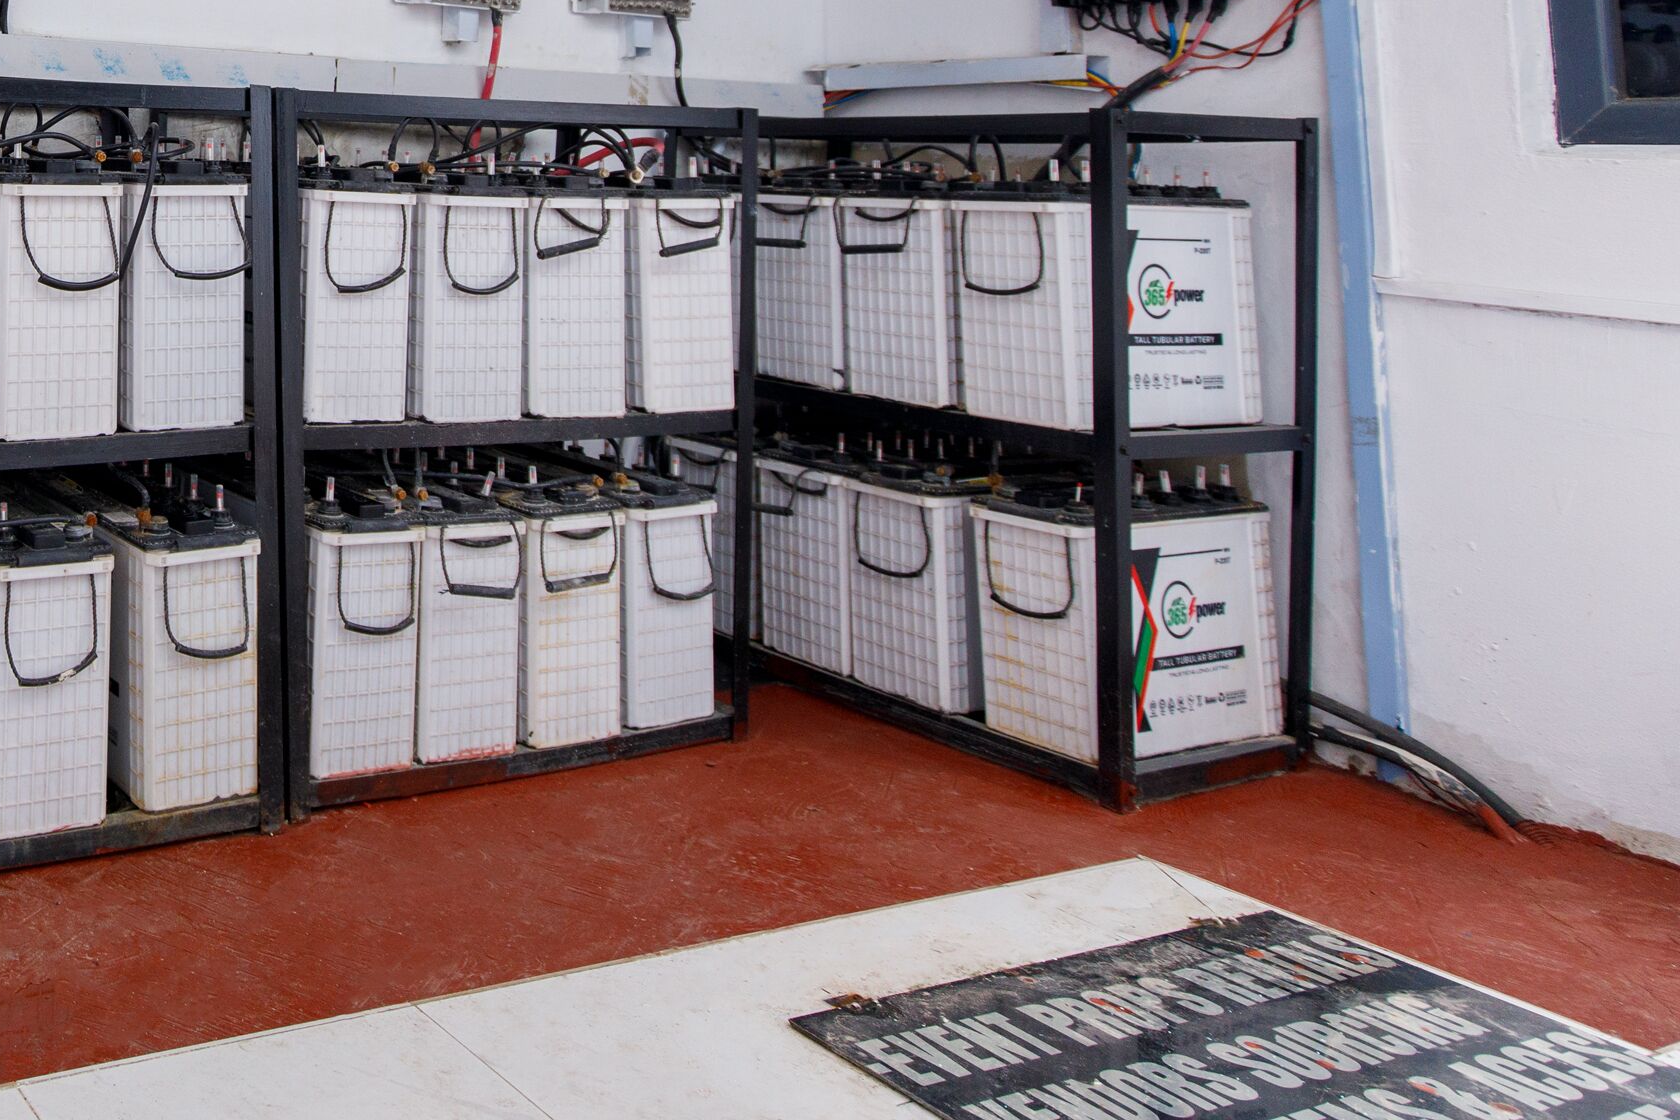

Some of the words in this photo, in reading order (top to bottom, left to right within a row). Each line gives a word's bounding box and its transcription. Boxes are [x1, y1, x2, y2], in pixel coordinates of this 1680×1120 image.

[1145, 289, 1165, 306] 365
[1174, 289, 1205, 307] power
[1134, 336, 1151, 344] TALL
[1152, 336, 1184, 344] TUBULAR
[1185, 336, 1216, 344] BATTERY
[1168, 608, 1187, 626] 365
[1196, 601, 1226, 623] power
[1015, 977, 1225, 1048] PROPS
[1205, 994, 1491, 1089] SOURCING
[1451, 1031, 1669, 1112] ACCES
